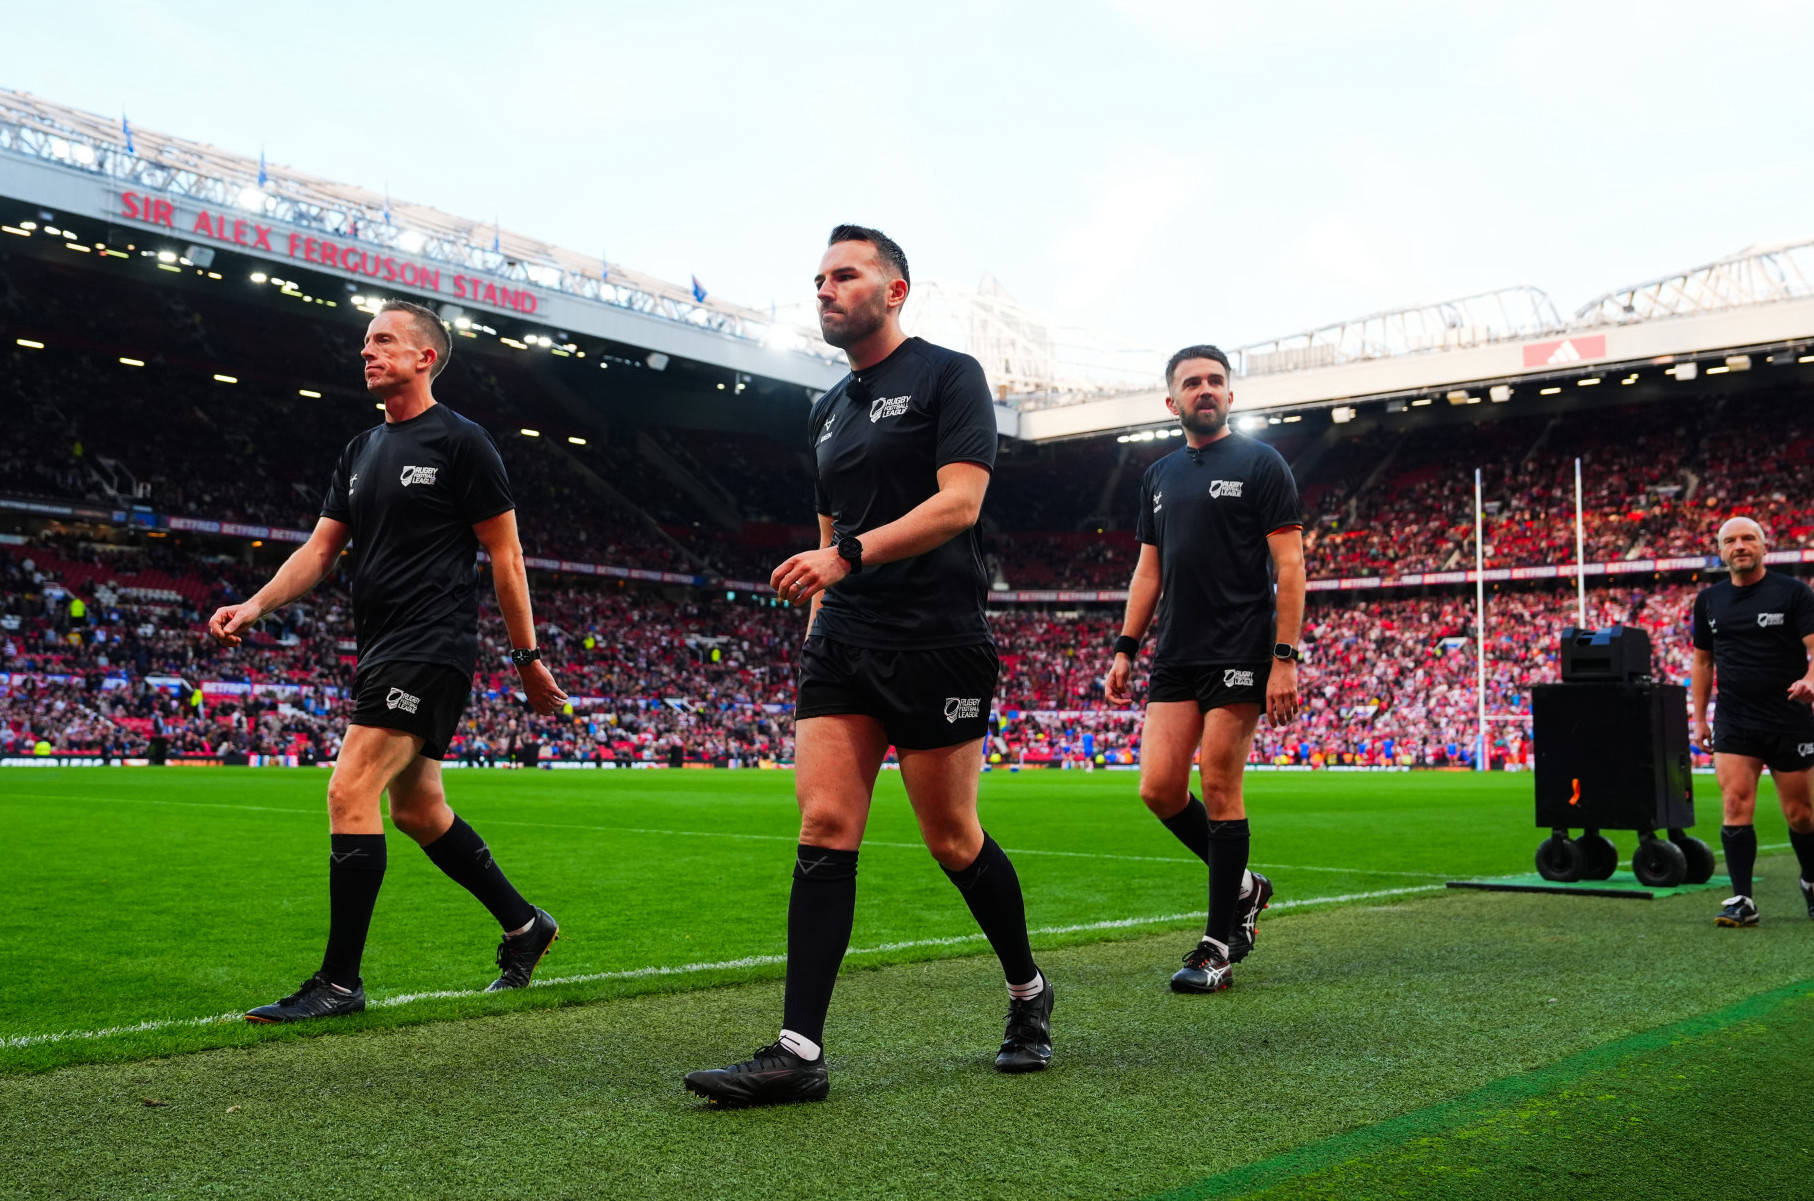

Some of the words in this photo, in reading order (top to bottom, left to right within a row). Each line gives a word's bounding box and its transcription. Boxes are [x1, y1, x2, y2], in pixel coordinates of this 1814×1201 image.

[120, 191, 175, 228] SIR
[193, 210, 274, 252] ALEX
[288, 232, 441, 292] FERGUSON
[453, 273, 539, 315] STAND
[884, 395, 912, 407] RUGBY
[882, 408, 908, 418] LEAGUE
[414, 466, 439, 474] RUGBY
[170, 517, 219, 532] BETFRED
[222, 523, 269, 538] BETFRED
[403, 692, 422, 705] RUGBY
[960, 698, 982, 706] RUGBY
[958, 711, 979, 719] LEAGUE
